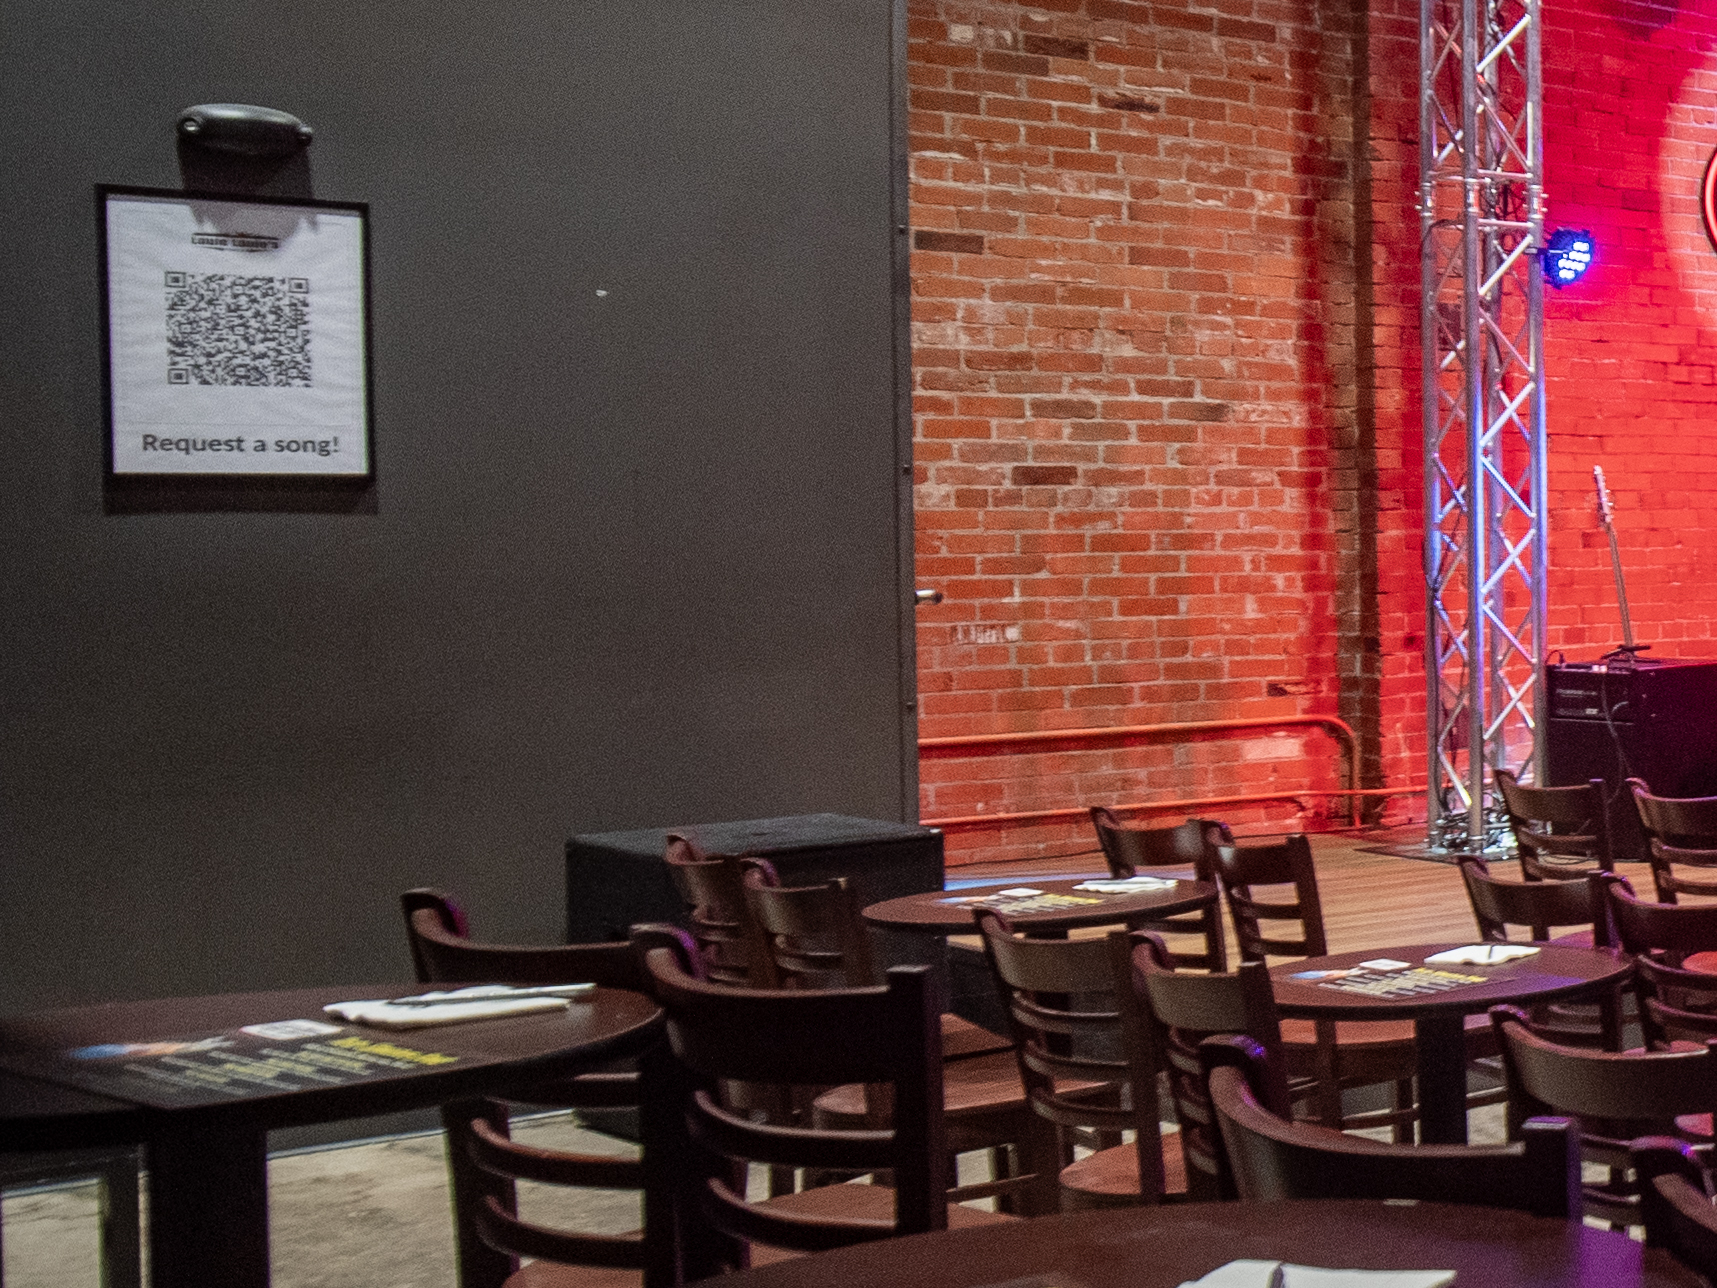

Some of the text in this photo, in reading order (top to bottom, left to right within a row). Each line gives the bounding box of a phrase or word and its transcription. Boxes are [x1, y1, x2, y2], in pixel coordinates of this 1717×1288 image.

[141, 433, 340, 457] Request a song!
